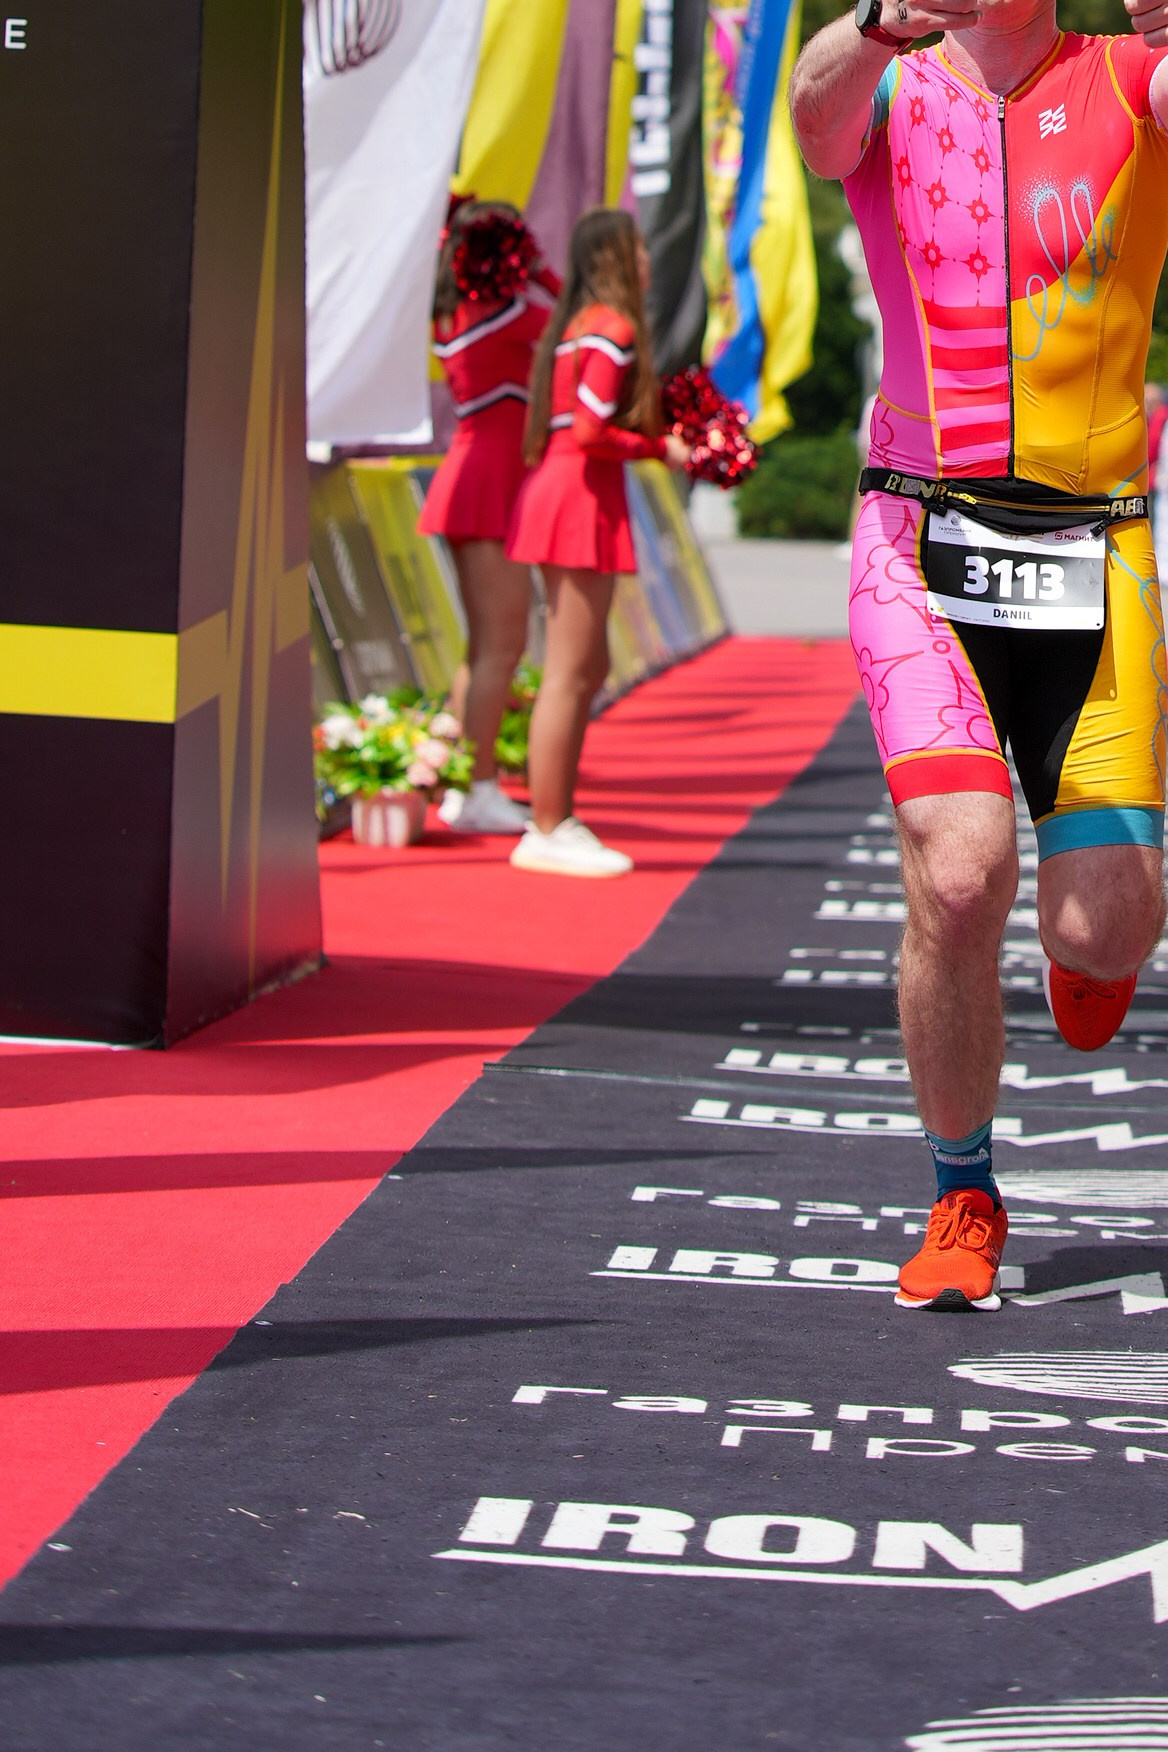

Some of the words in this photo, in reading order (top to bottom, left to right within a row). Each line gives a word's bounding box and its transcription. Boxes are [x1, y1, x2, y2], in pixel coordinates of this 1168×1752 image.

[963, 555, 1065, 601] 3113
[993, 608, 1033, 621] DANIIL
[723, 1047, 1028, 1080] IRO
[690, 1098, 1023, 1137] IRO
[606, 1244, 1025, 1291] IRO
[458, 1495, 1024, 1572] IRON
